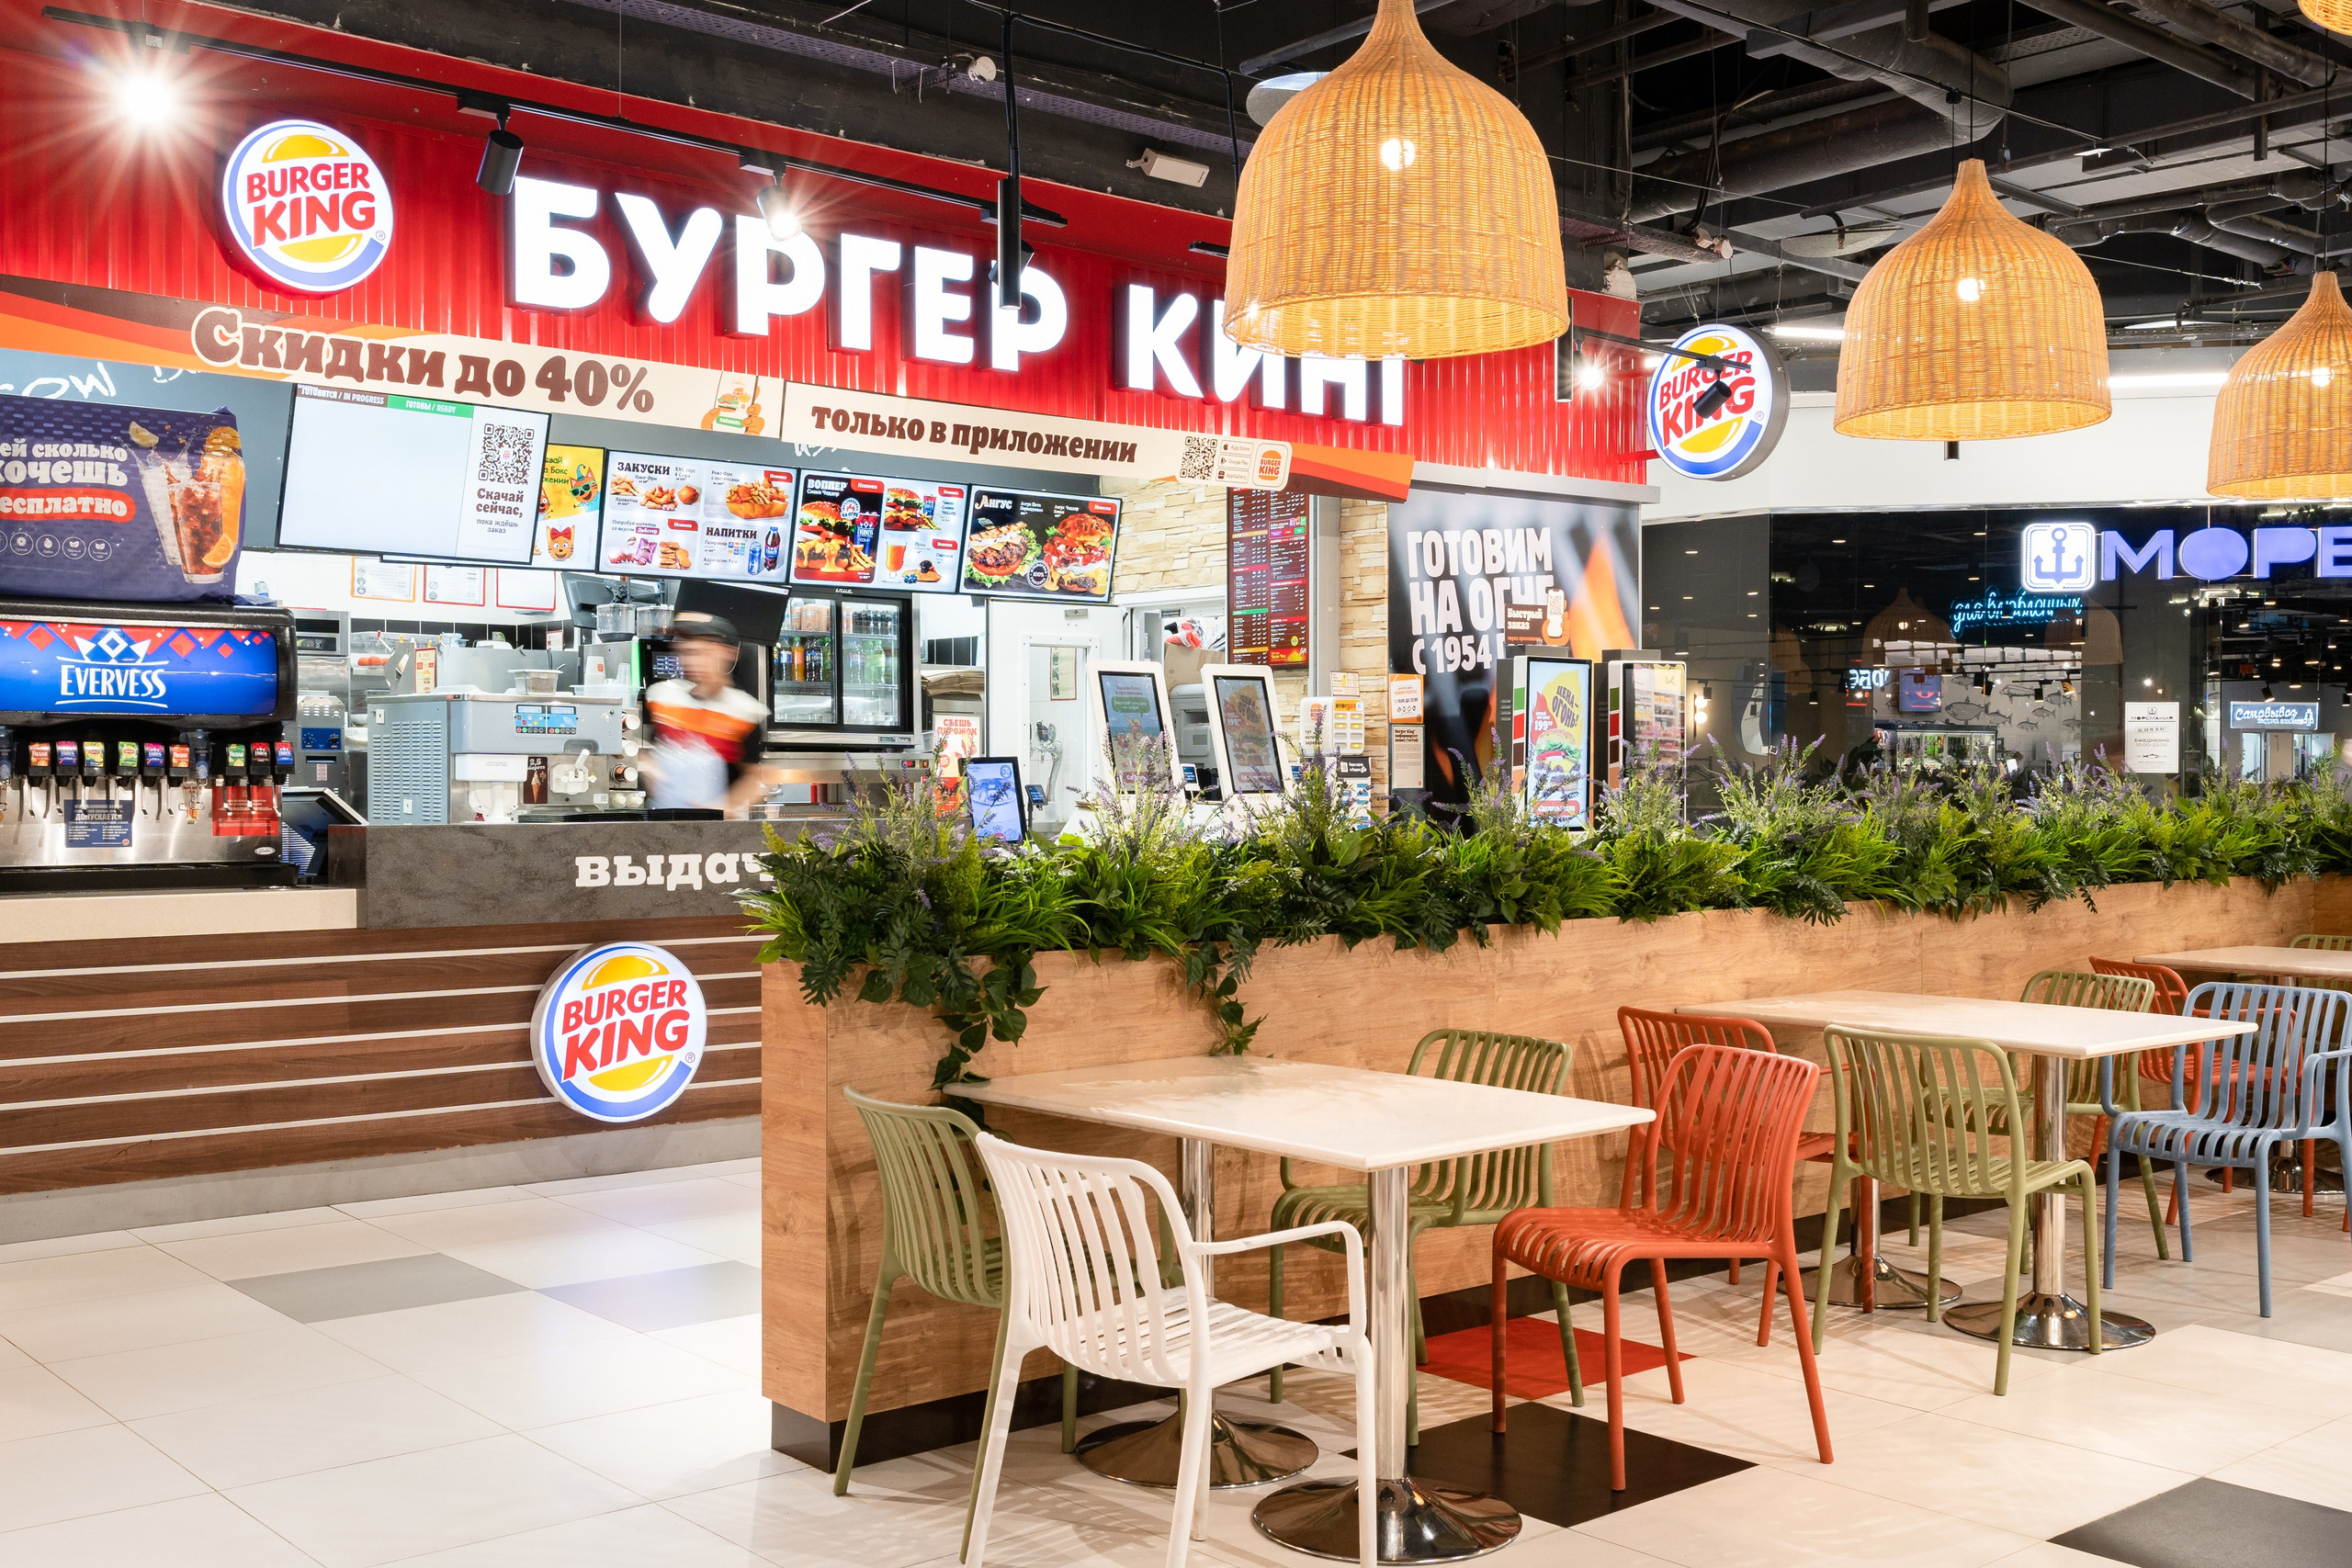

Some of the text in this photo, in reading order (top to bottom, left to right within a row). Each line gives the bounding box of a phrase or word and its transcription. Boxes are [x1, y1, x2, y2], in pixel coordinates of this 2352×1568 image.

[247, 161, 370, 205] BURGER
[253, 191, 376, 247] KING
[516, 175, 1068, 372] БУРГЕР
[193, 309, 654, 413] Скидки до 40%
[352, 393, 385, 405] PROGRESS
[405, 400, 431, 411] ГОТОВЫ
[435, 404, 457, 413] READY
[810, 404, 1137, 463] только в приложении
[31, 443, 129, 462] сколько
[617, 461, 671, 476] ЗАКУСКИ
[1259, 466, 1280, 476] KING
[1260, 458, 1281, 467] BURGER
[0, 460, 129, 487] очешь
[542, 476, 570, 485] жении
[807, 479, 848, 492] ВОППЕР
[477, 487, 525, 503] Скачай
[975, 494, 1012, 510] Ангус
[0, 496, 129, 517] есплатно
[475, 502, 524, 518] сейчас,
[476, 518, 492, 527] пока
[706, 526, 758, 539] НАПИТКИ
[1407, 526, 1553, 578] ГОТОВИМ
[1408, 580, 1463, 636] НА
[1507, 607, 1544, 622] Быстрый
[1507, 621, 1530, 630] заказ
[1412, 637, 1427, 675] С
[1430, 634, 1493, 674] 1954
[60, 664, 167, 699] EVERVESS
[1556, 685, 1575, 708] ЦЕНА
[1552, 695, 1579, 728] ОГОНЬ!
[937, 727, 978, 736] ПИРОЖОК
[943, 718, 972, 728] СЪЕШЬ
[561, 979, 687, 1034] BURGER
[563, 1009, 690, 1081] KING
